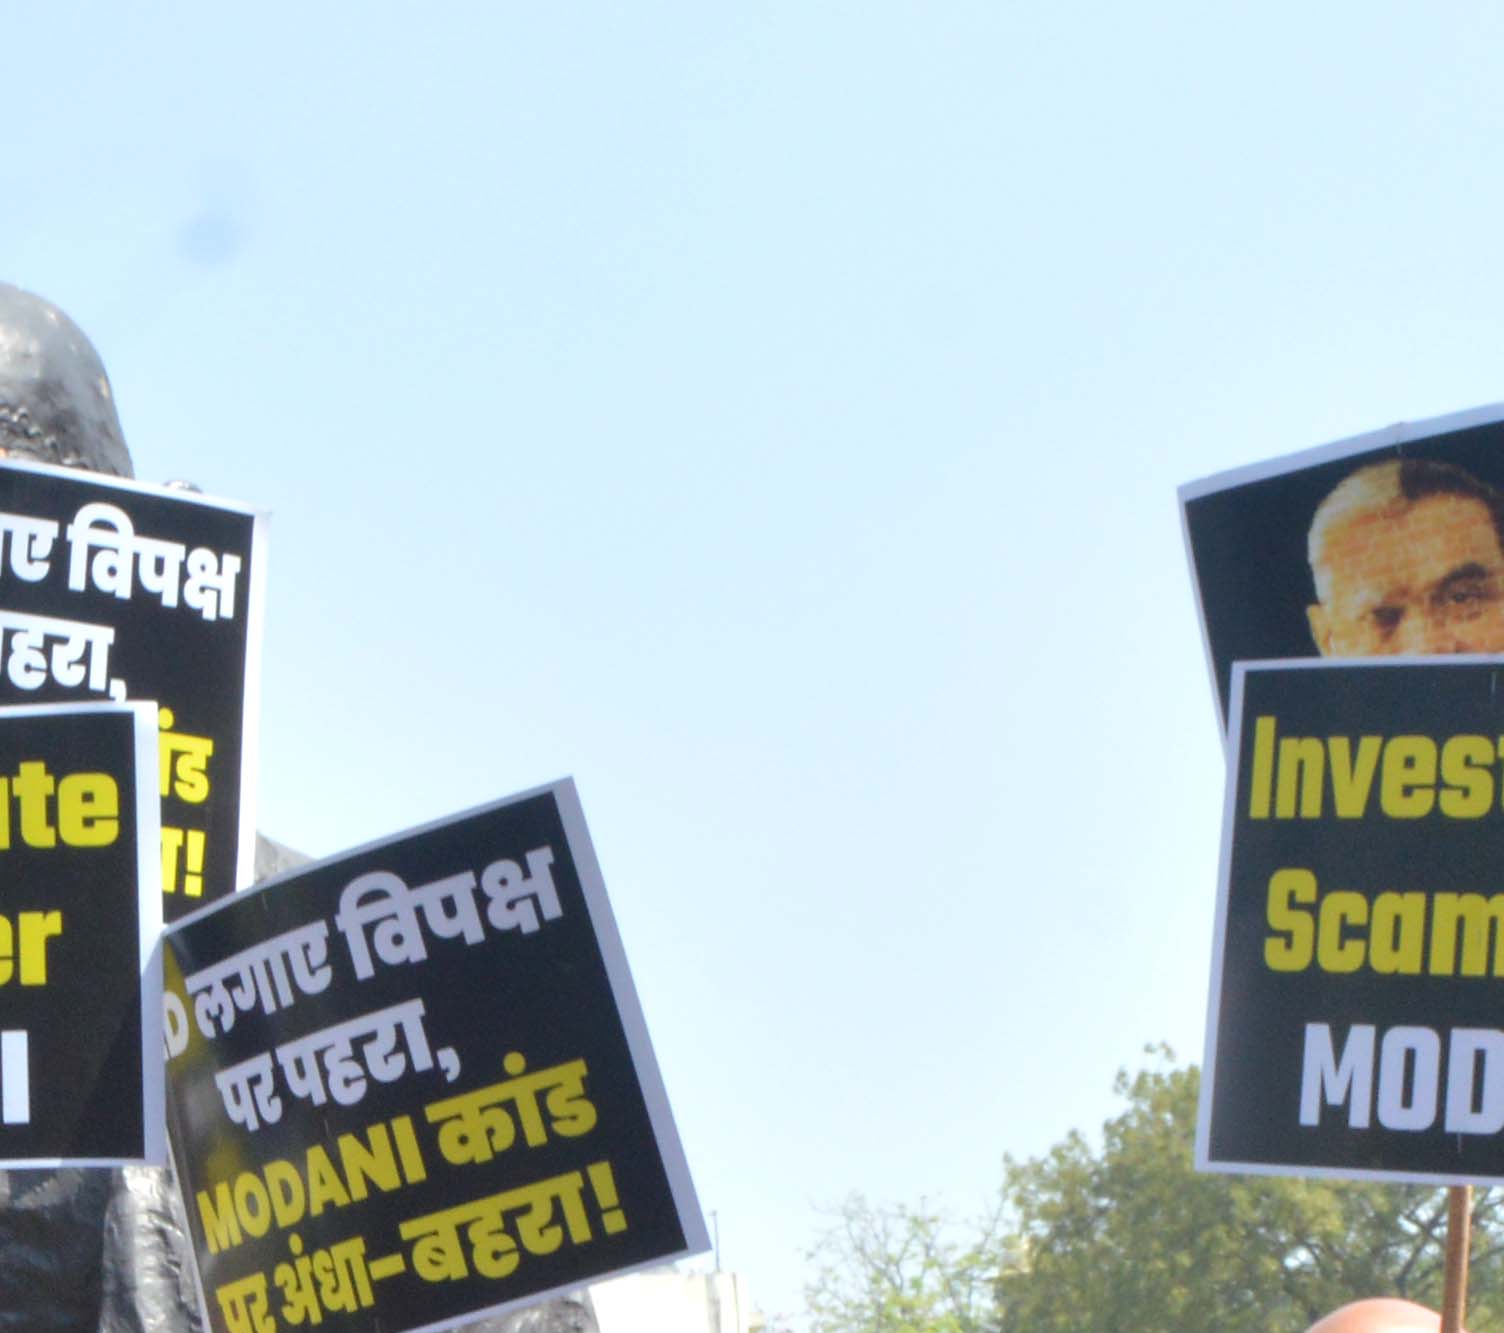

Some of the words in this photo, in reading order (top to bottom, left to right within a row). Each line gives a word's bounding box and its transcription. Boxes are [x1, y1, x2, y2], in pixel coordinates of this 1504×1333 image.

[66, 503, 241, 622] विपक्ष
[186, 919, 332, 1041] लगाए
[335, 845, 564, 981] विपक्ष
[214, 1048, 284, 1133] पर
[278, 997, 461, 1107] पहरा,
[196, 1114, 428, 1256] MODANI
[424, 1051, 598, 1167] कांड
